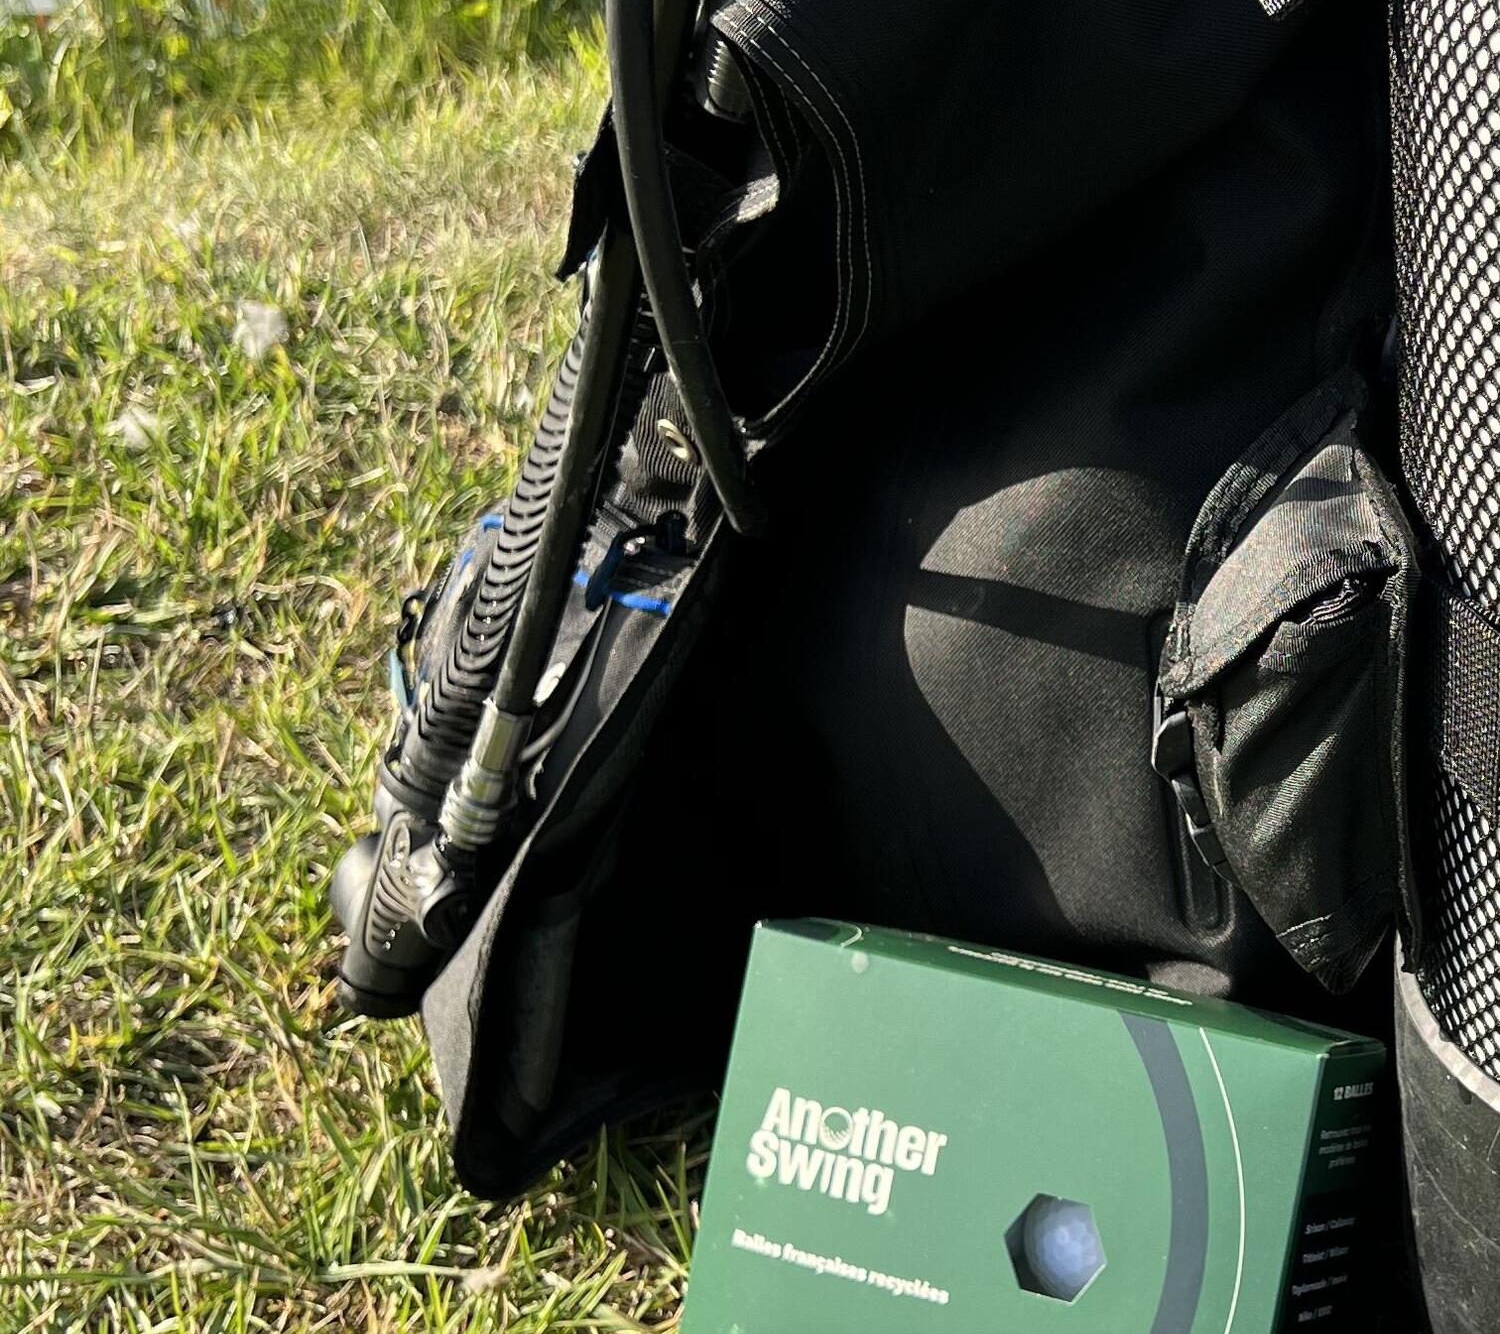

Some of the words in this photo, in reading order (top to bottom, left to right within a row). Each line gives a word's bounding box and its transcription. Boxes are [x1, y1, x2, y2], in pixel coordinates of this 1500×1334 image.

[746, 1130, 894, 1216] Swing
[761, 1087, 948, 1176] Another
[731, 1228, 782, 1258] Balles
